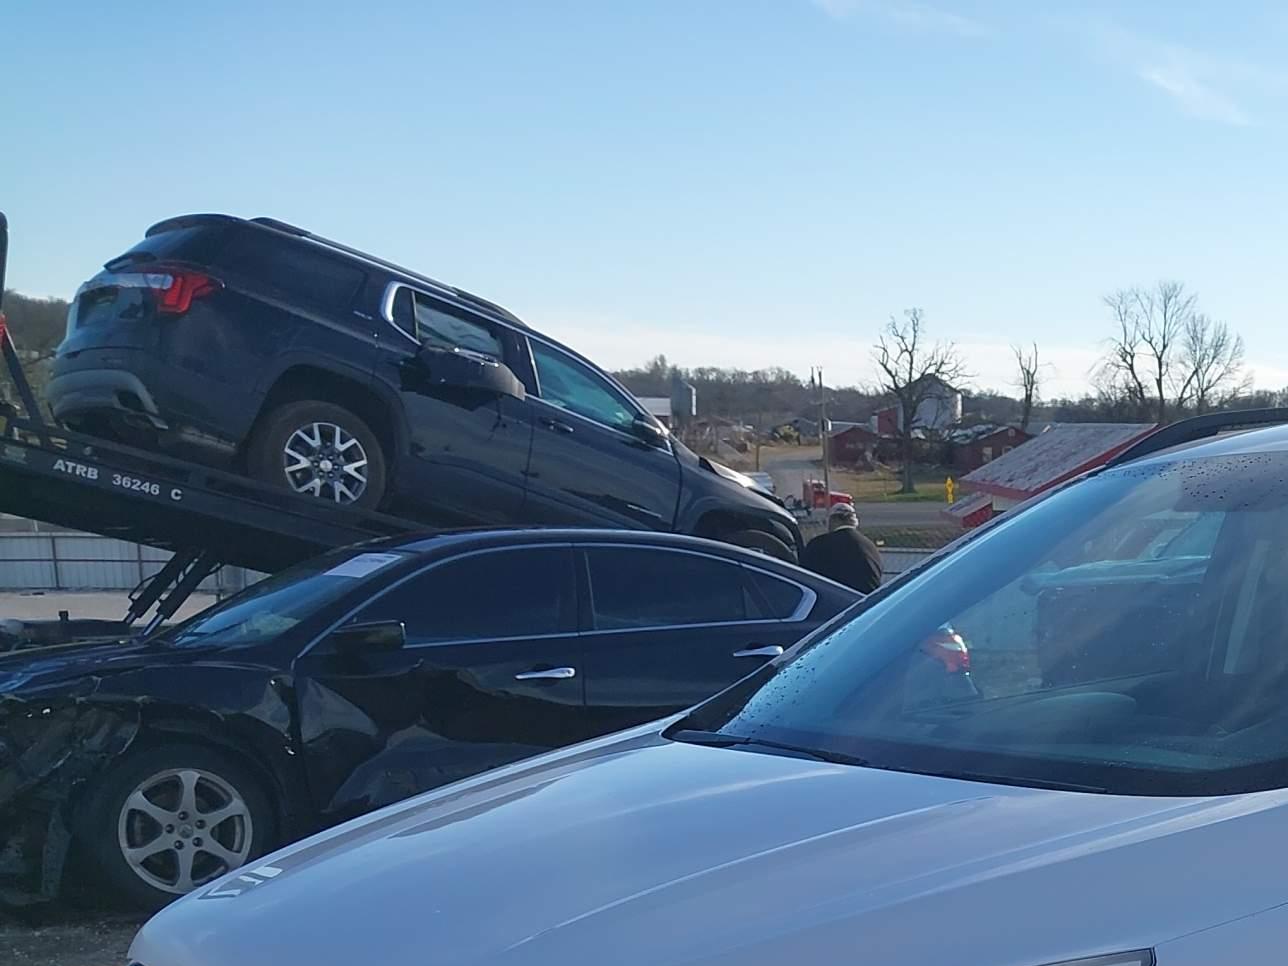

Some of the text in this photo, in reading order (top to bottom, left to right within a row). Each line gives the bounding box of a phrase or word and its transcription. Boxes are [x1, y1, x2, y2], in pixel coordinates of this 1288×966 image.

[53, 459, 182, 500] ATRB 36246 C
